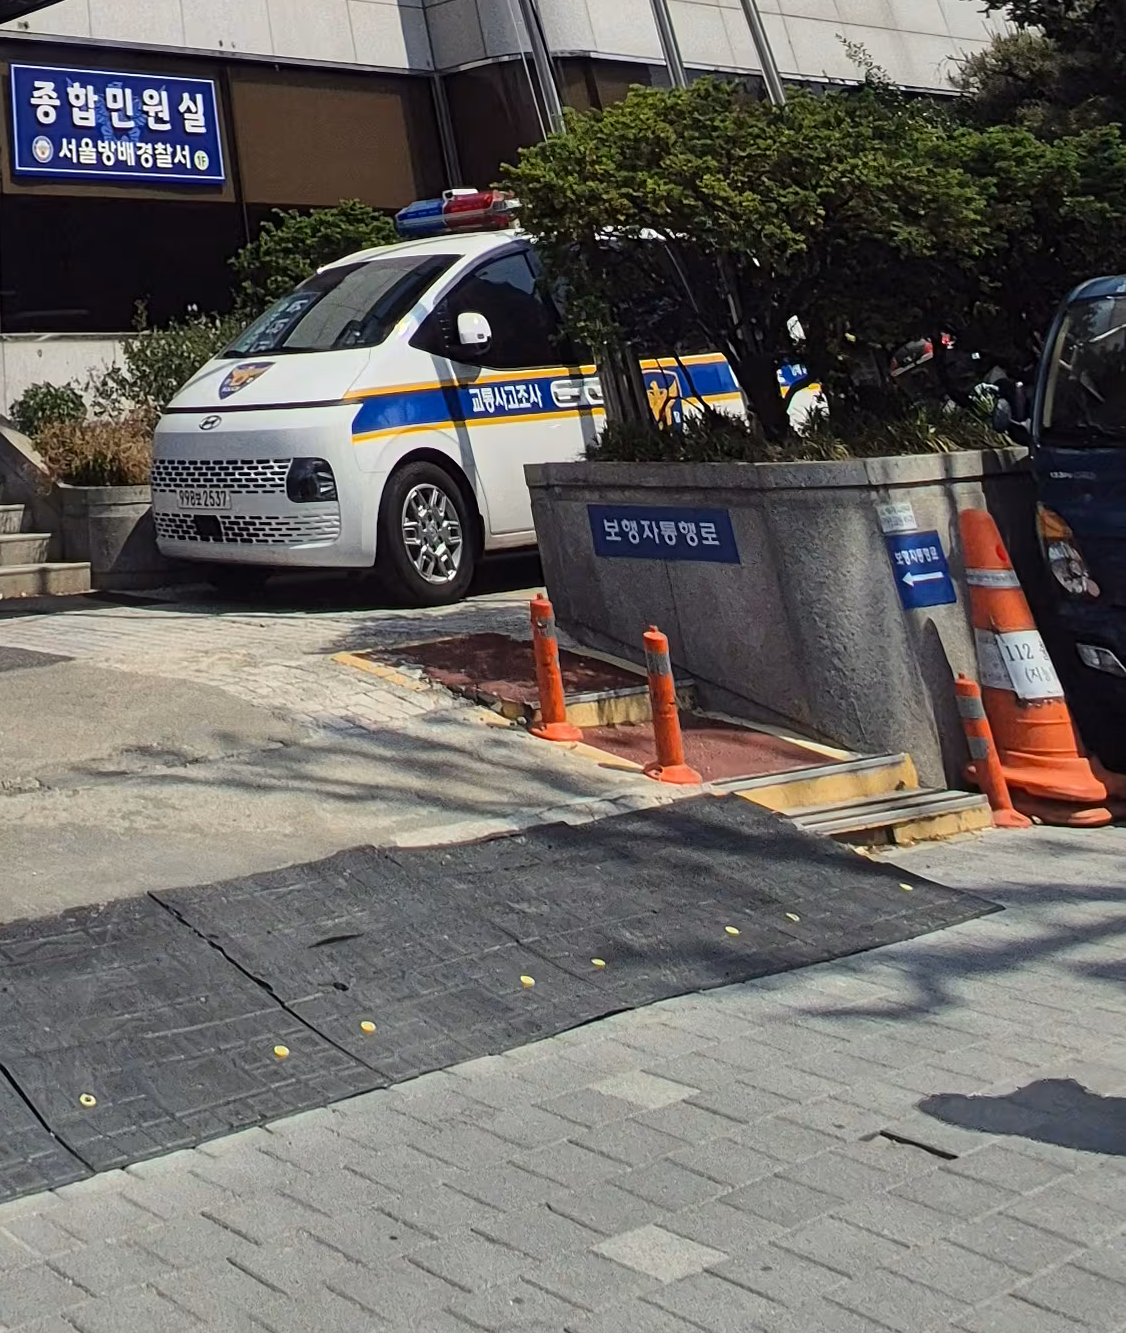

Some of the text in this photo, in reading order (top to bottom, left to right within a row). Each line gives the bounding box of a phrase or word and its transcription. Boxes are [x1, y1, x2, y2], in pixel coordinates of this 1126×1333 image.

[30, 80, 207, 134] 종합민원실
[58, 137, 192, 169] 서울방배경찰서
[469, 383, 543, 413] 교통사고조사
[603, 517, 720, 547] 보행자통행로
[894, 546, 940, 565] 보행자통행로
[1005, 643, 1034, 662] 112
